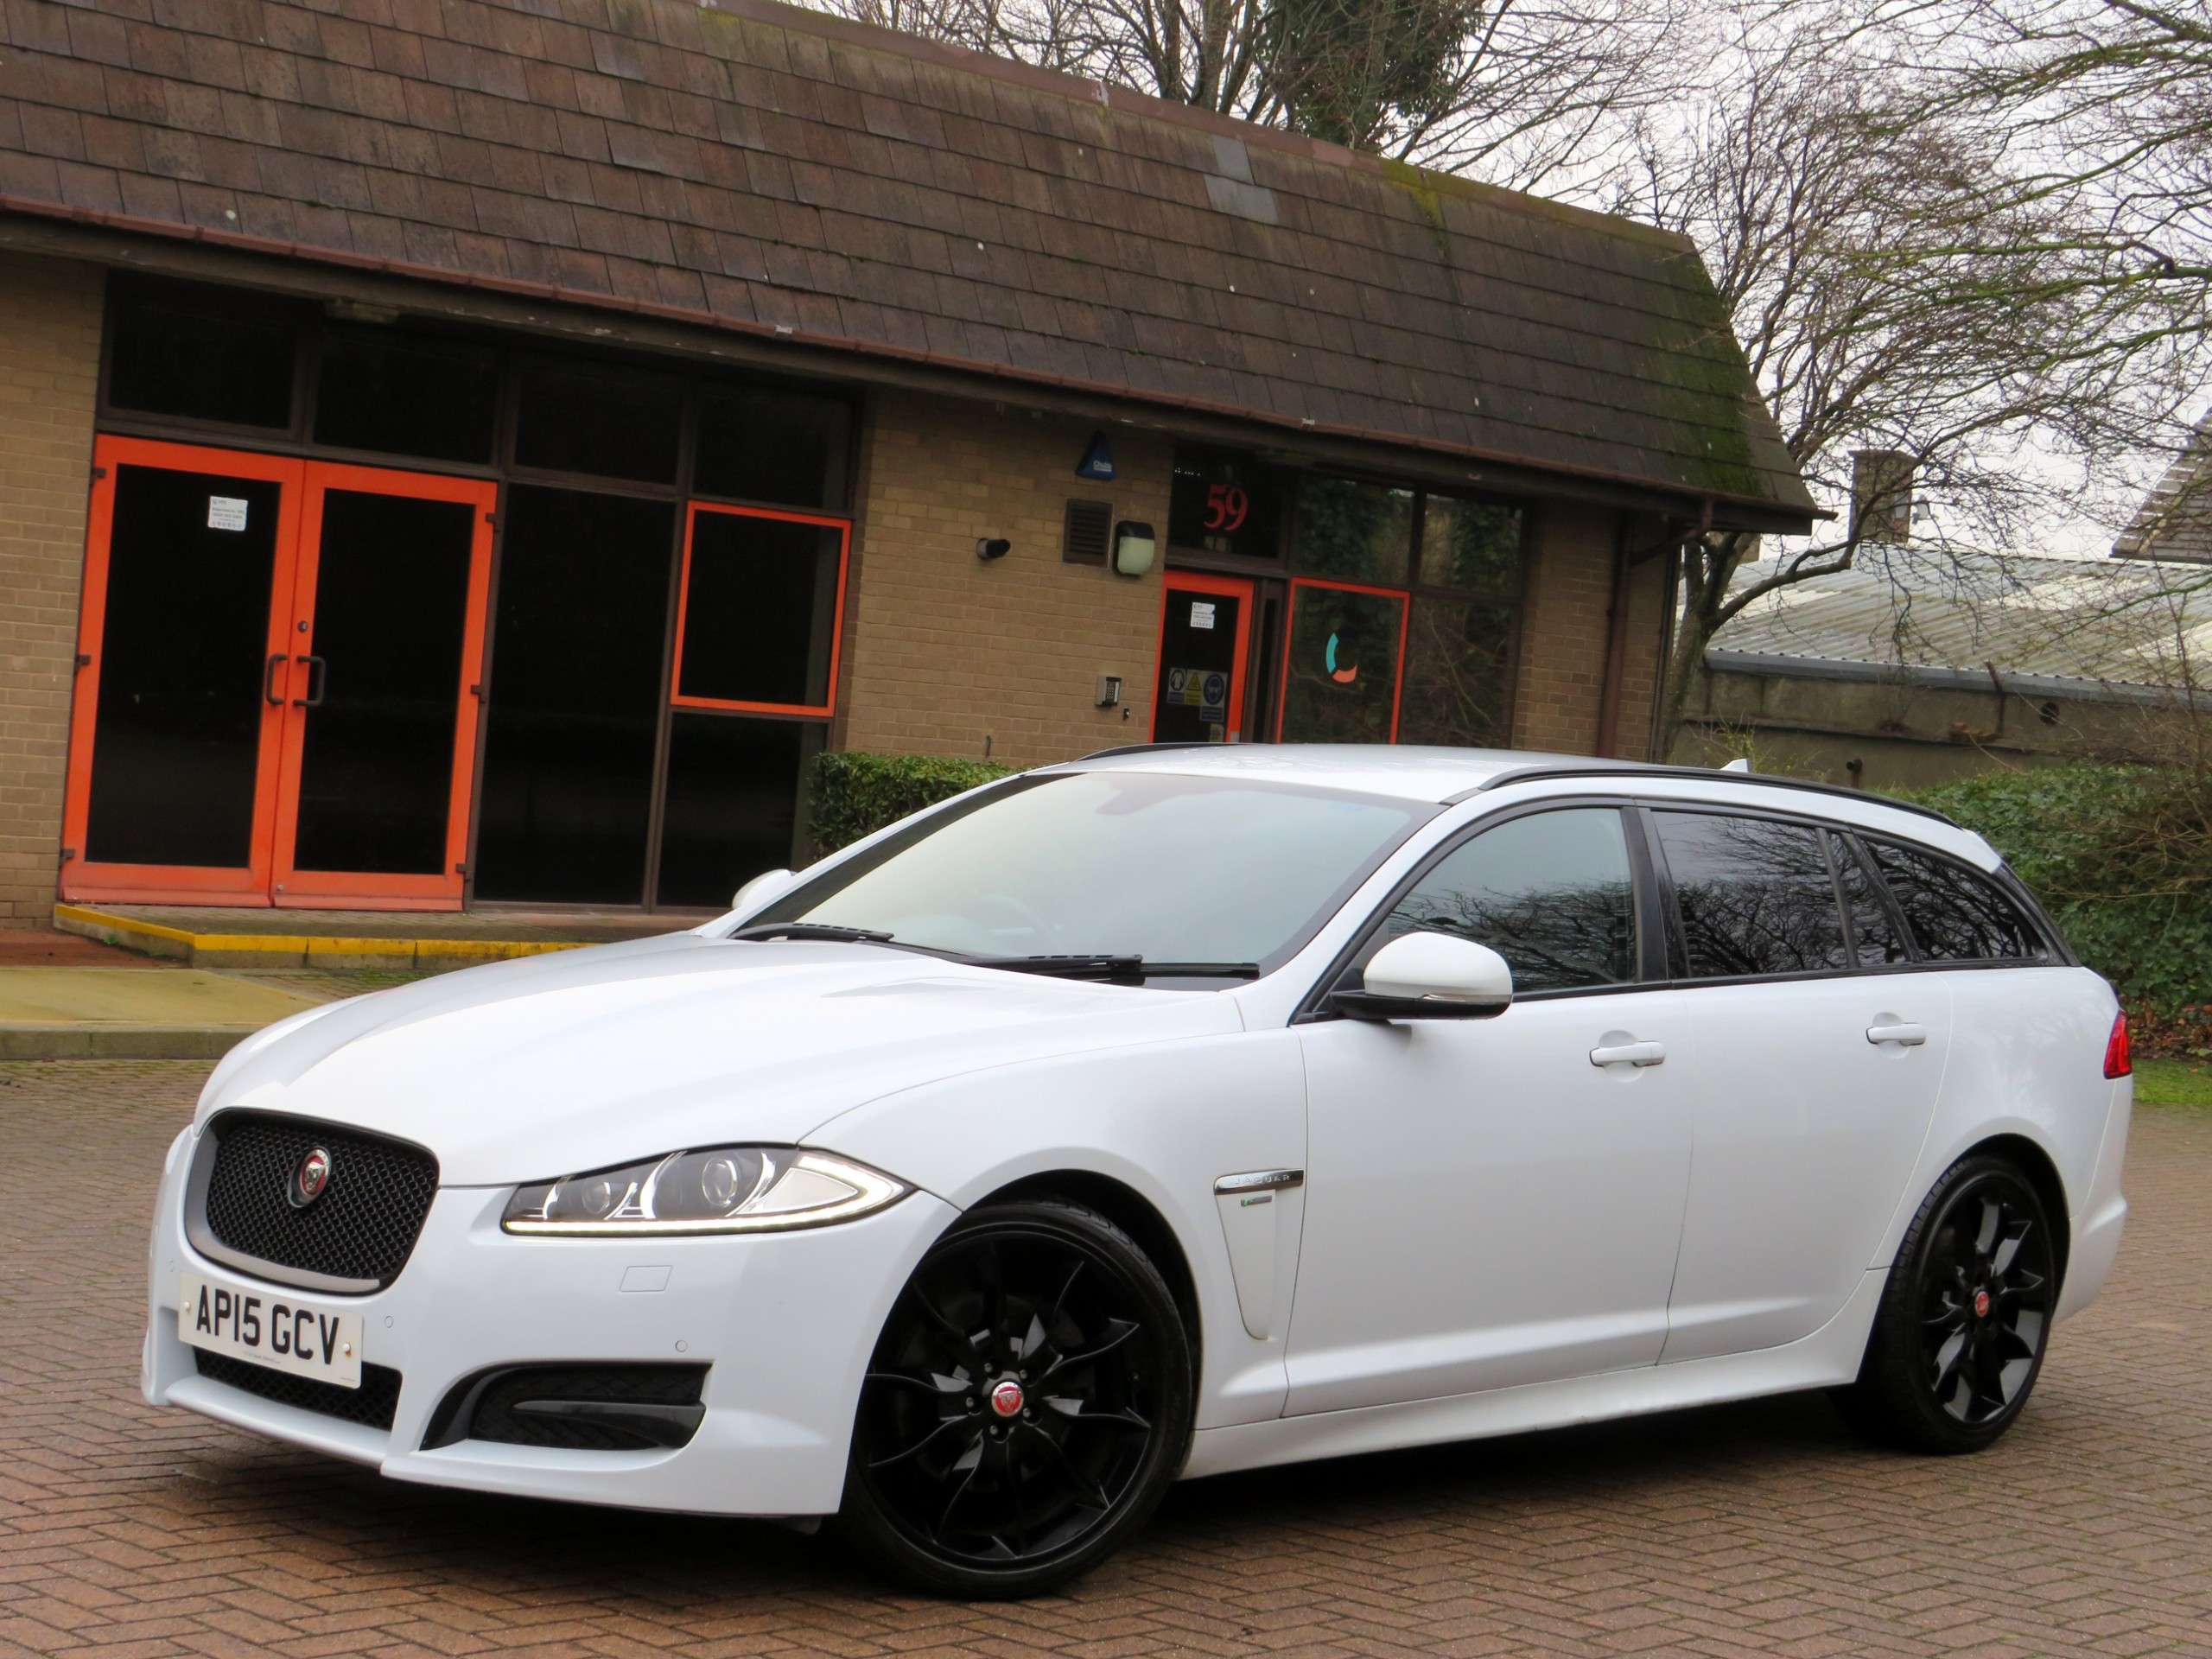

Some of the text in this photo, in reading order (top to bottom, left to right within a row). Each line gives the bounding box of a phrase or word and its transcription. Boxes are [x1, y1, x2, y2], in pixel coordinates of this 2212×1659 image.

[1204, 484, 1249, 531] 59
[1236, 1174, 1291, 1183] JAGUAR
[196, 1284, 340, 1365] AP15 GCV
